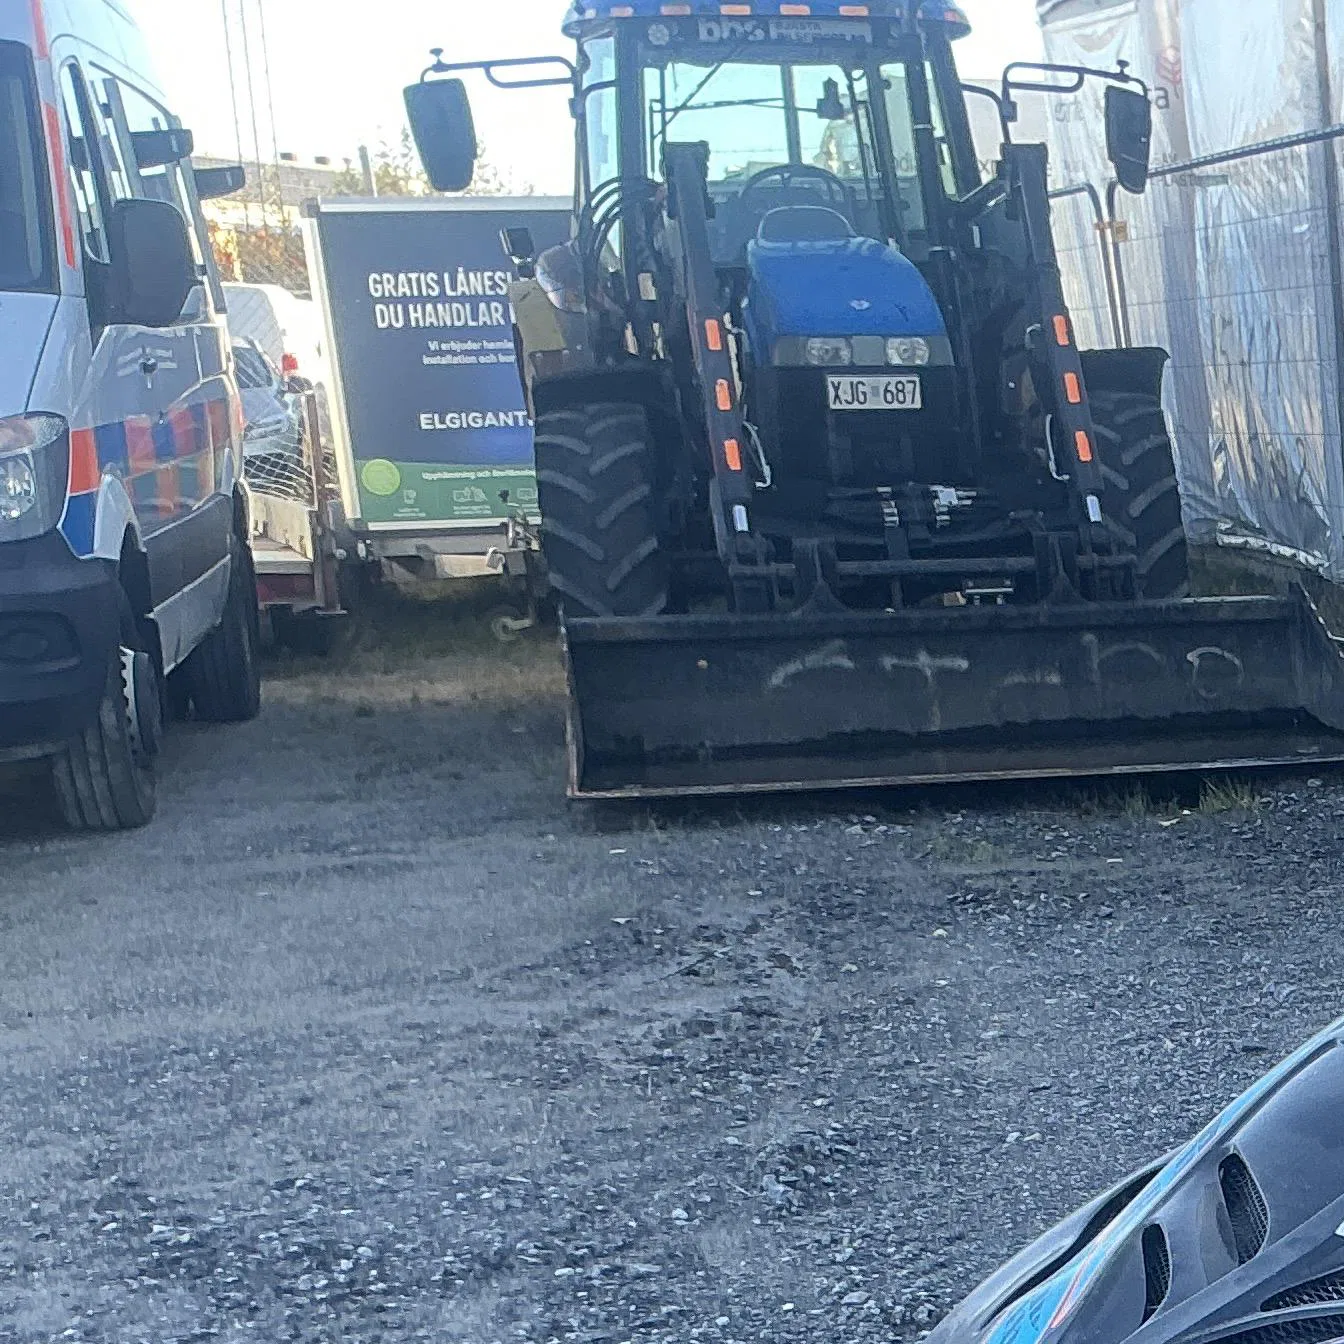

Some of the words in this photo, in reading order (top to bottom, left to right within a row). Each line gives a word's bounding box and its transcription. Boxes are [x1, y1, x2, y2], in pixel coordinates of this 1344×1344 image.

[368, 271, 440, 298] GRATIS
[375, 303, 404, 329] DU
[408, 302, 505, 328] HANDLAR
[830, 380, 867, 405] XJG
[883, 380, 916, 405] 687
[419, 410, 534, 430] ELGIGANT
